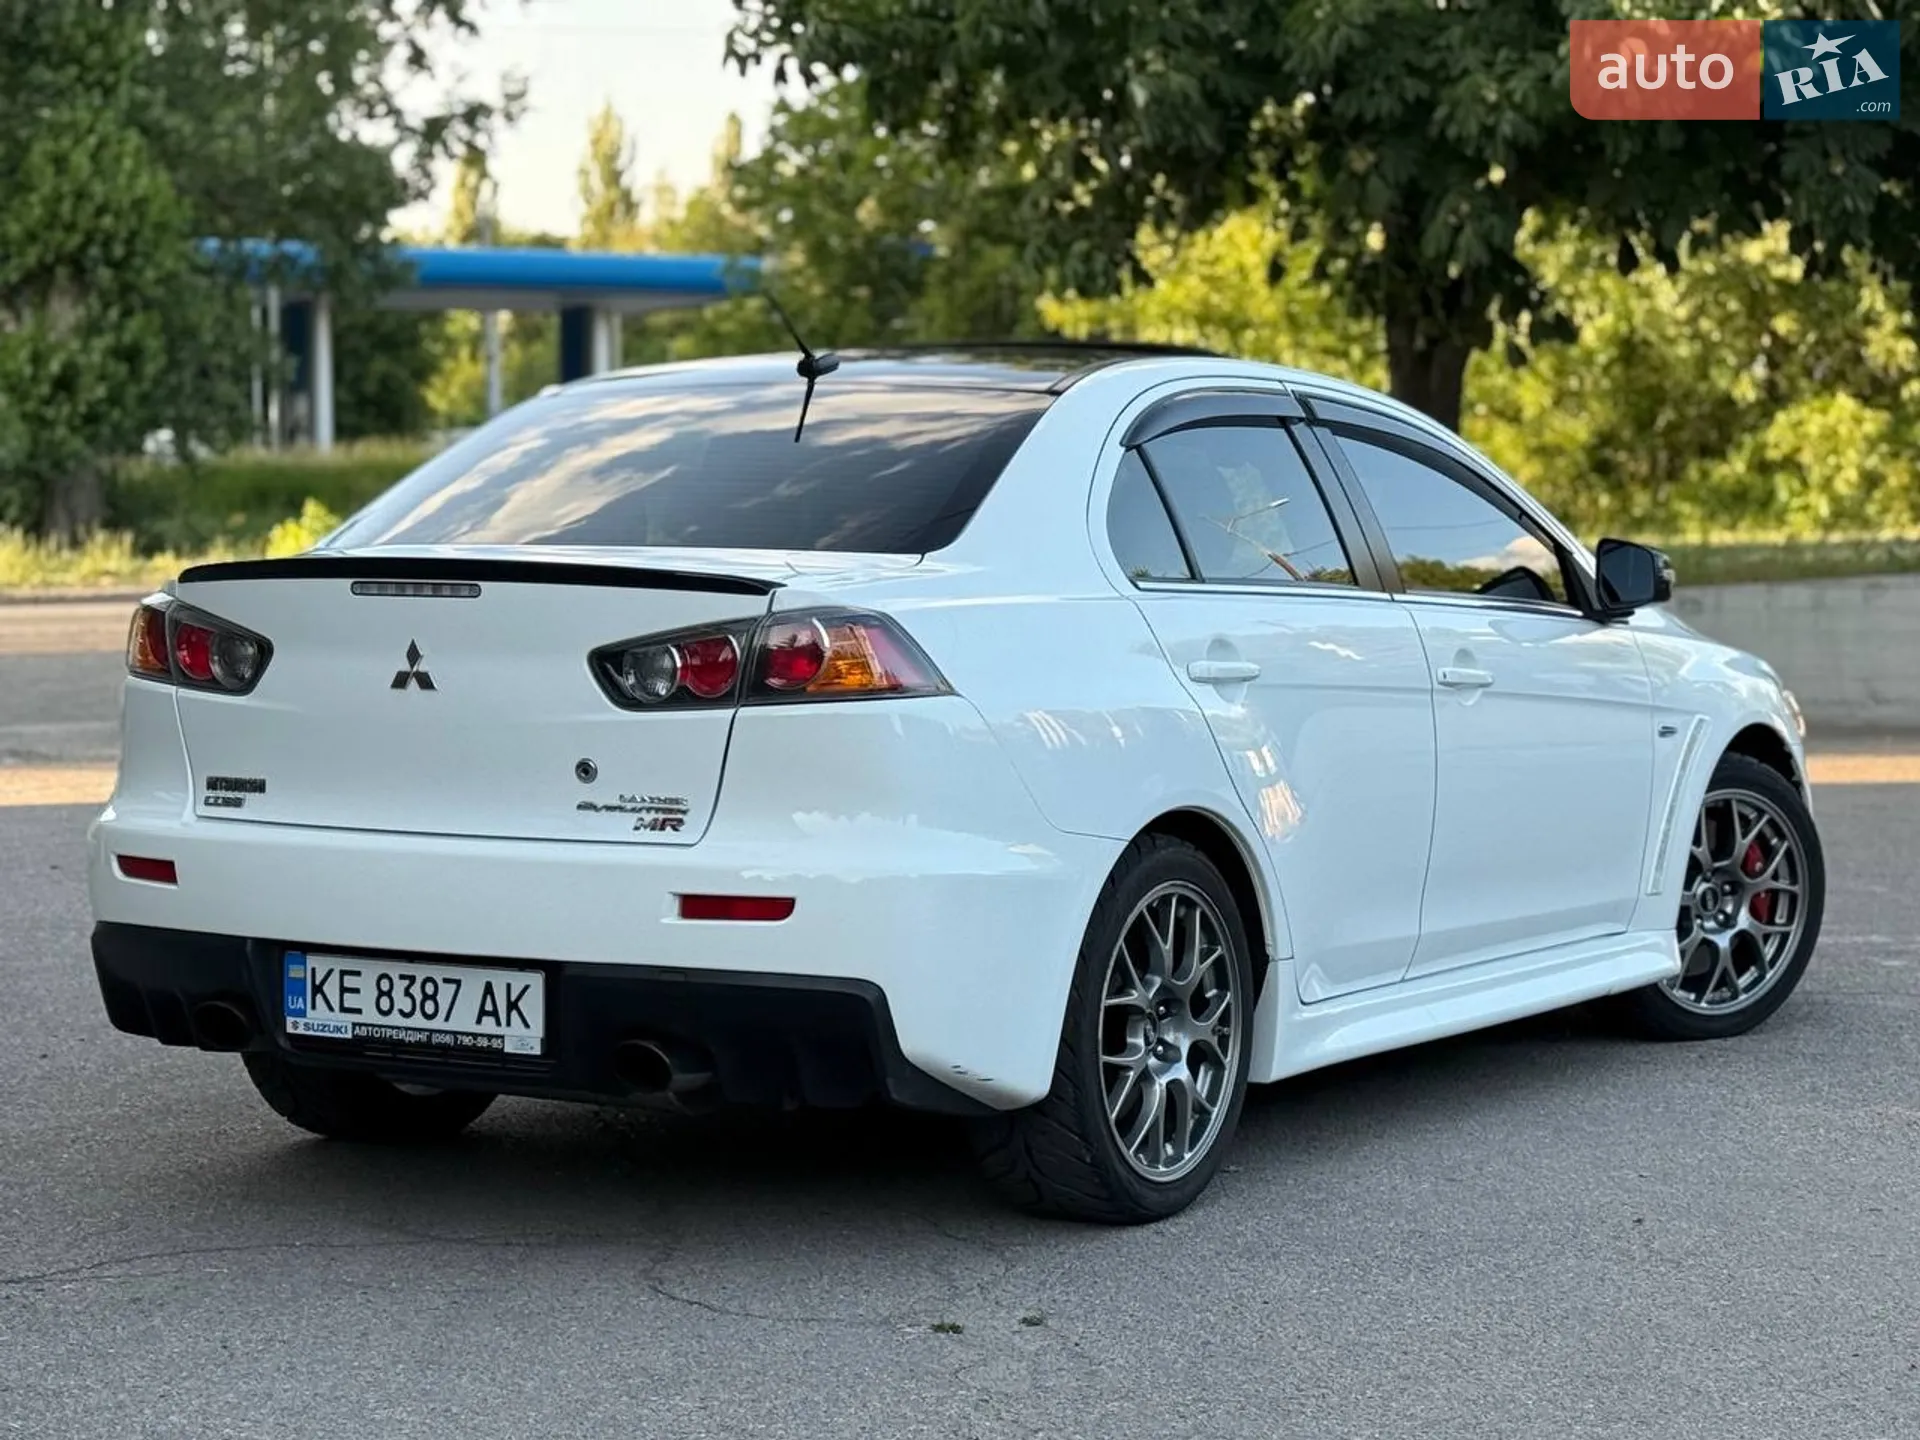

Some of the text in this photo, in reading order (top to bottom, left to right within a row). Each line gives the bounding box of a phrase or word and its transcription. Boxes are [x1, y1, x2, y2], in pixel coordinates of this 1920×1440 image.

[632, 817, 685, 832] MR
[288, 996, 305, 1010] UA
[310, 966, 531, 1029] KE 8387 AK
[303, 1021, 348, 1035] SUZUKI
